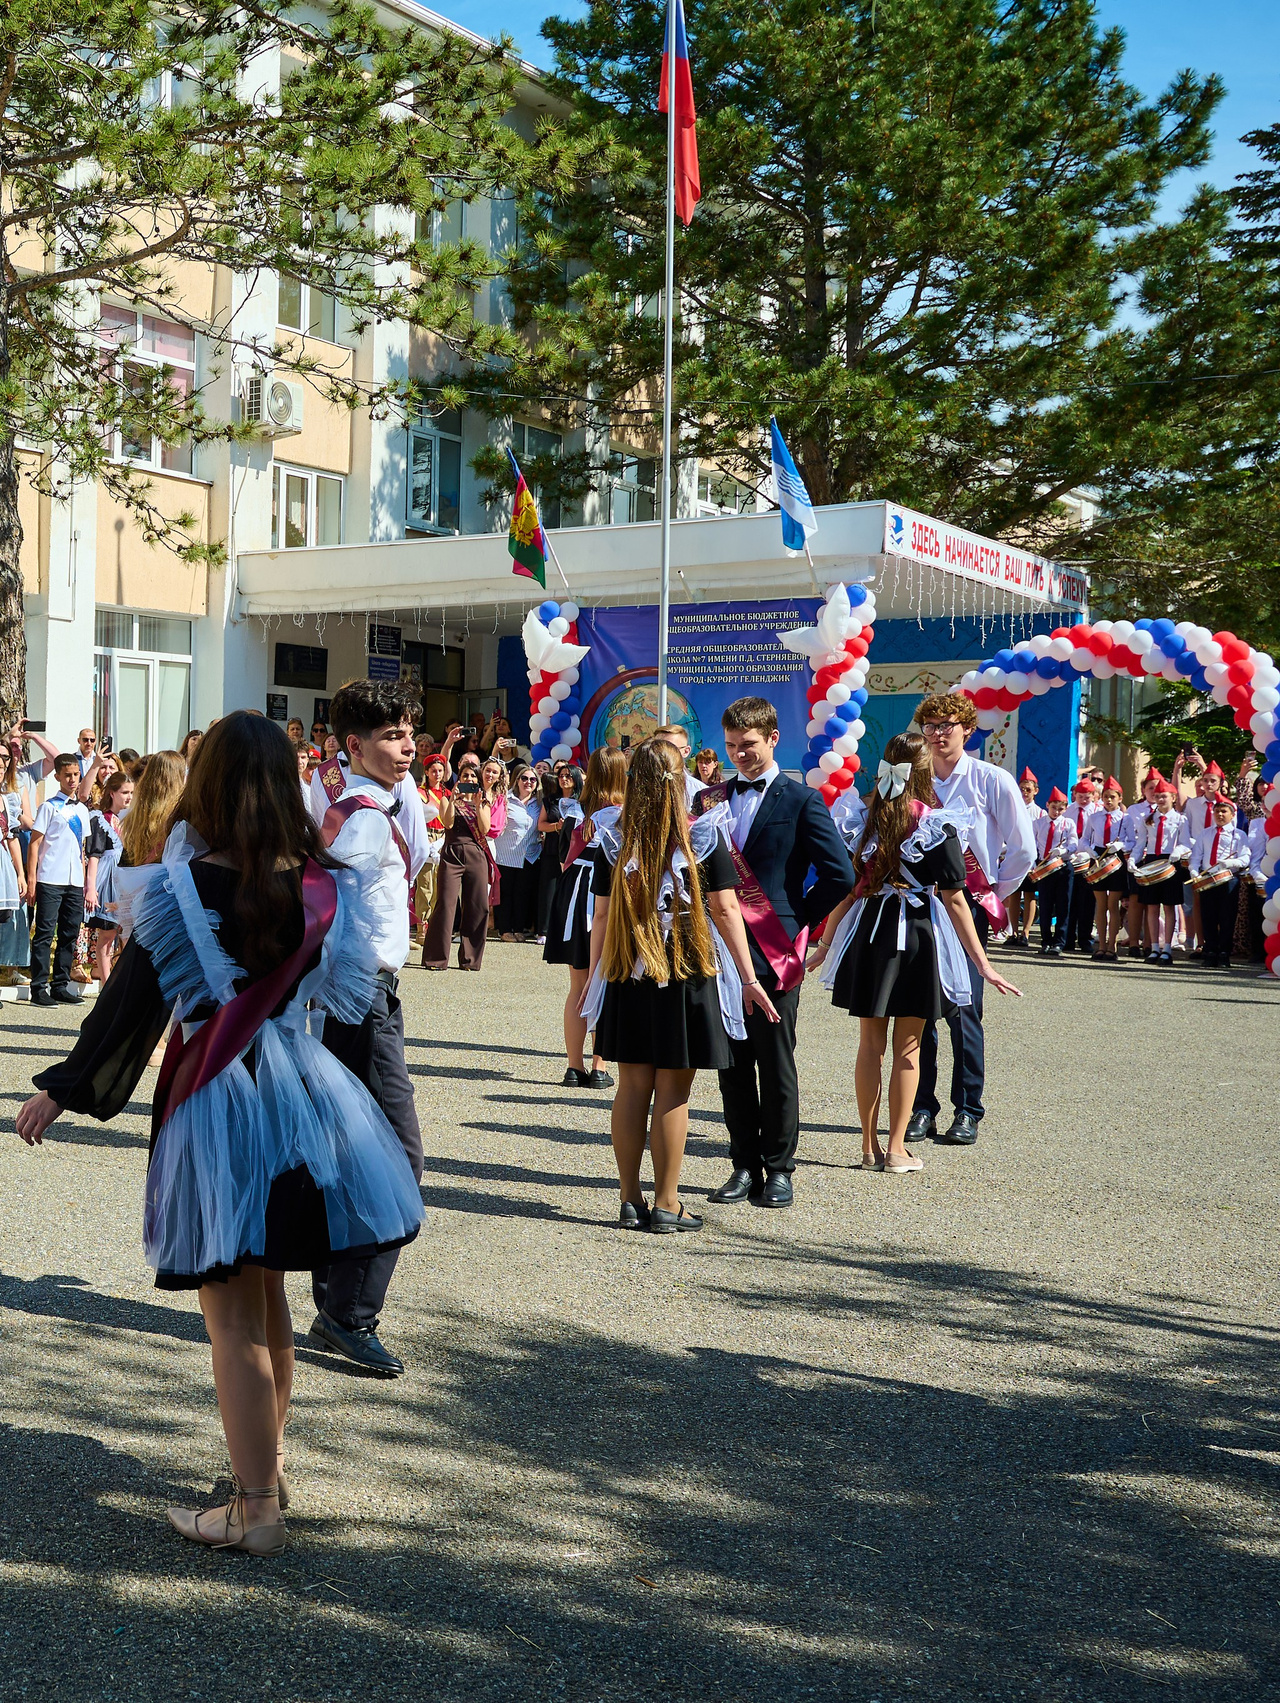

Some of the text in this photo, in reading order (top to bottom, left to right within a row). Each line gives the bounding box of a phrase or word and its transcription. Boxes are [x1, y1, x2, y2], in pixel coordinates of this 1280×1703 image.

[911, 521, 940, 559] ЗДЕСЬ
[945, 535, 1001, 578] НАЧИНАЕТСЯ
[1004, 554, 1023, 585] ВАШ
[1025, 561, 1044, 591] ПУТЬ
[1048, 569, 1054, 595] К
[673, 611, 799, 623] МУНИЦИПАЛЬНОЕ БЮДЖЕТНОЕ
[667, 623, 758, 634] ЩЕОБРАЗОВАТЕЛЬНОЕ
[708, 655, 737, 663] ИМЕНИ
[739, 655, 755, 663] П.Д.
[667, 664, 803, 674] МУНИЦИПАЛЬНОГО ОБРАЗОВАНИЯ
[680, 674, 790, 684] ГОРОД-КУРОРТ ГЕЛЕНДЖИК
